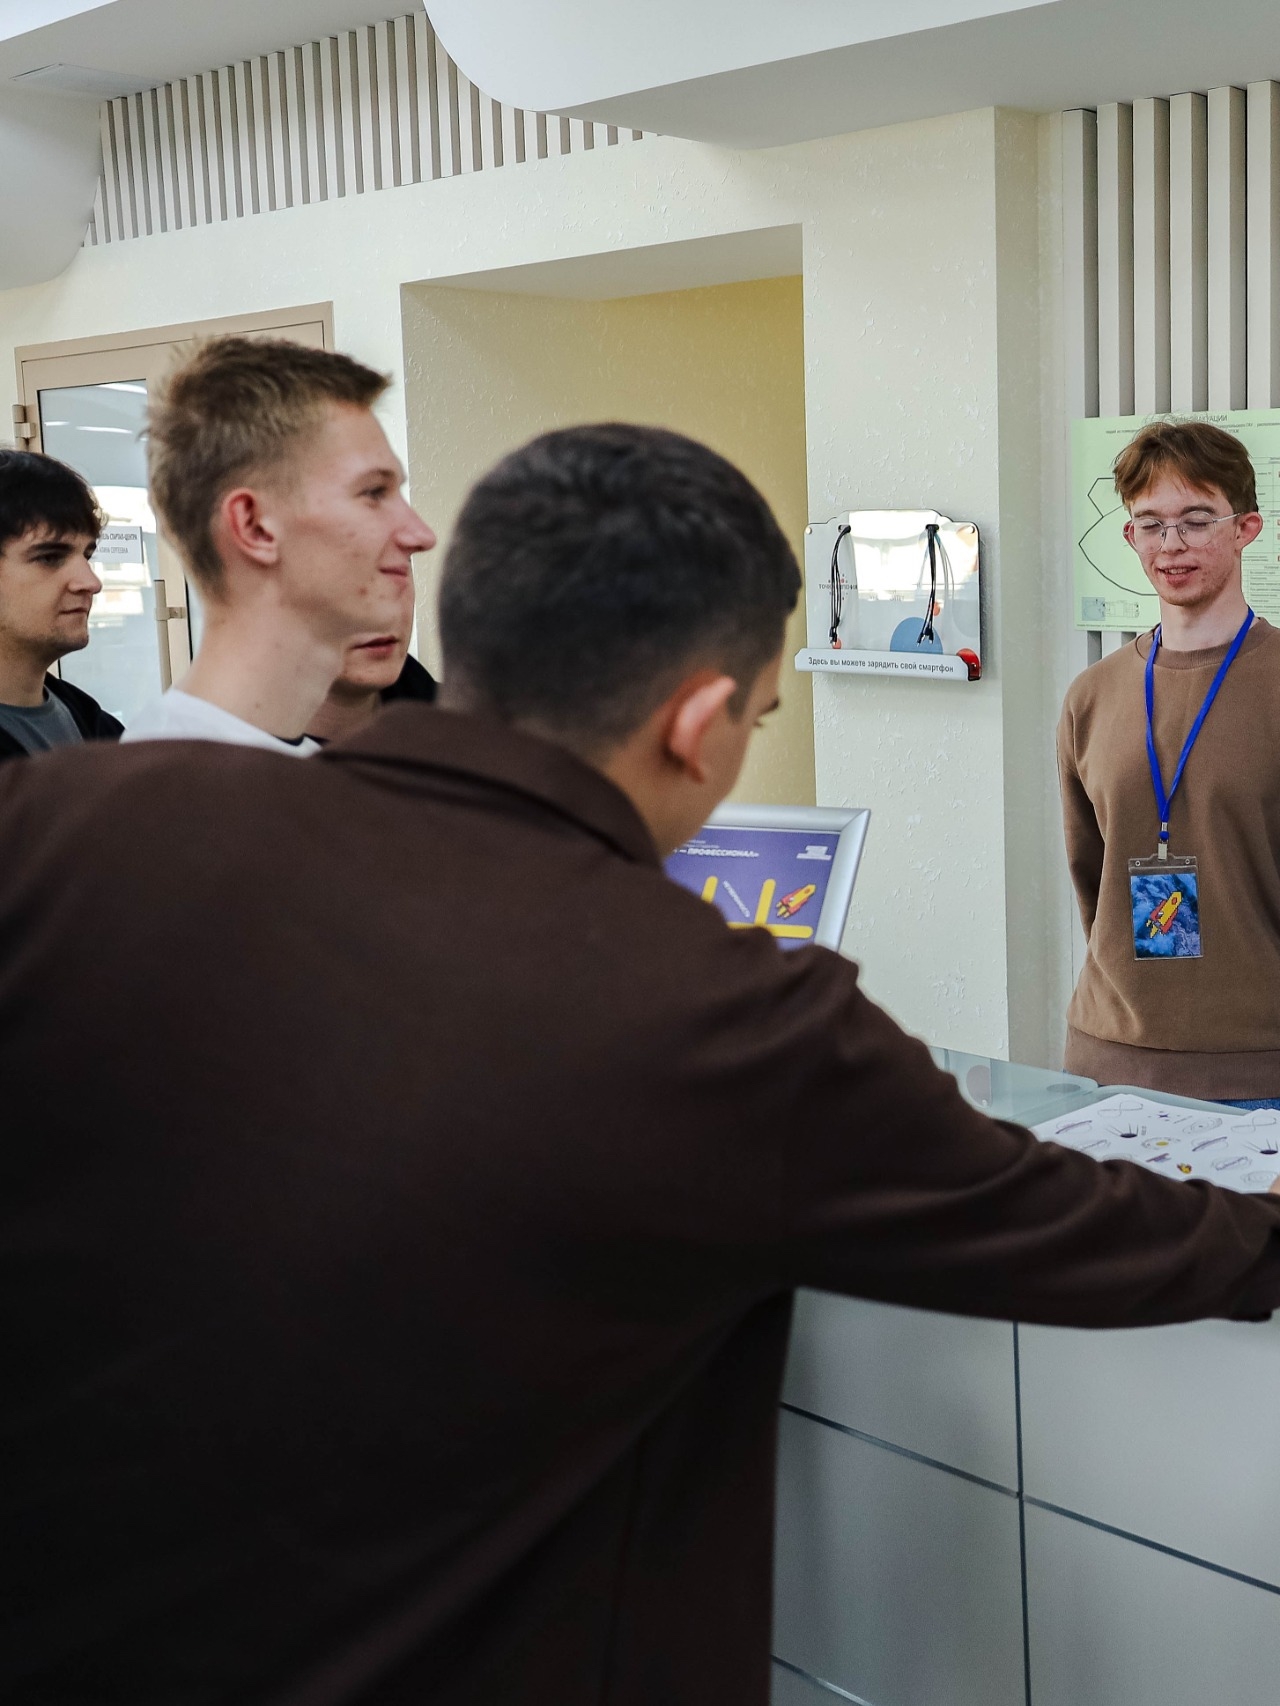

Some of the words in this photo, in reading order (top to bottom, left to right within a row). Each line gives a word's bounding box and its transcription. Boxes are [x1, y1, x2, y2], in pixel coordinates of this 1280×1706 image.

[808, 656, 828, 666] Здесь
[841, 659, 866, 668] можете
[867, 660, 899, 670] зарядить
[900, 661, 917, 670] свой
[918, 663, 954, 674] смартфон
